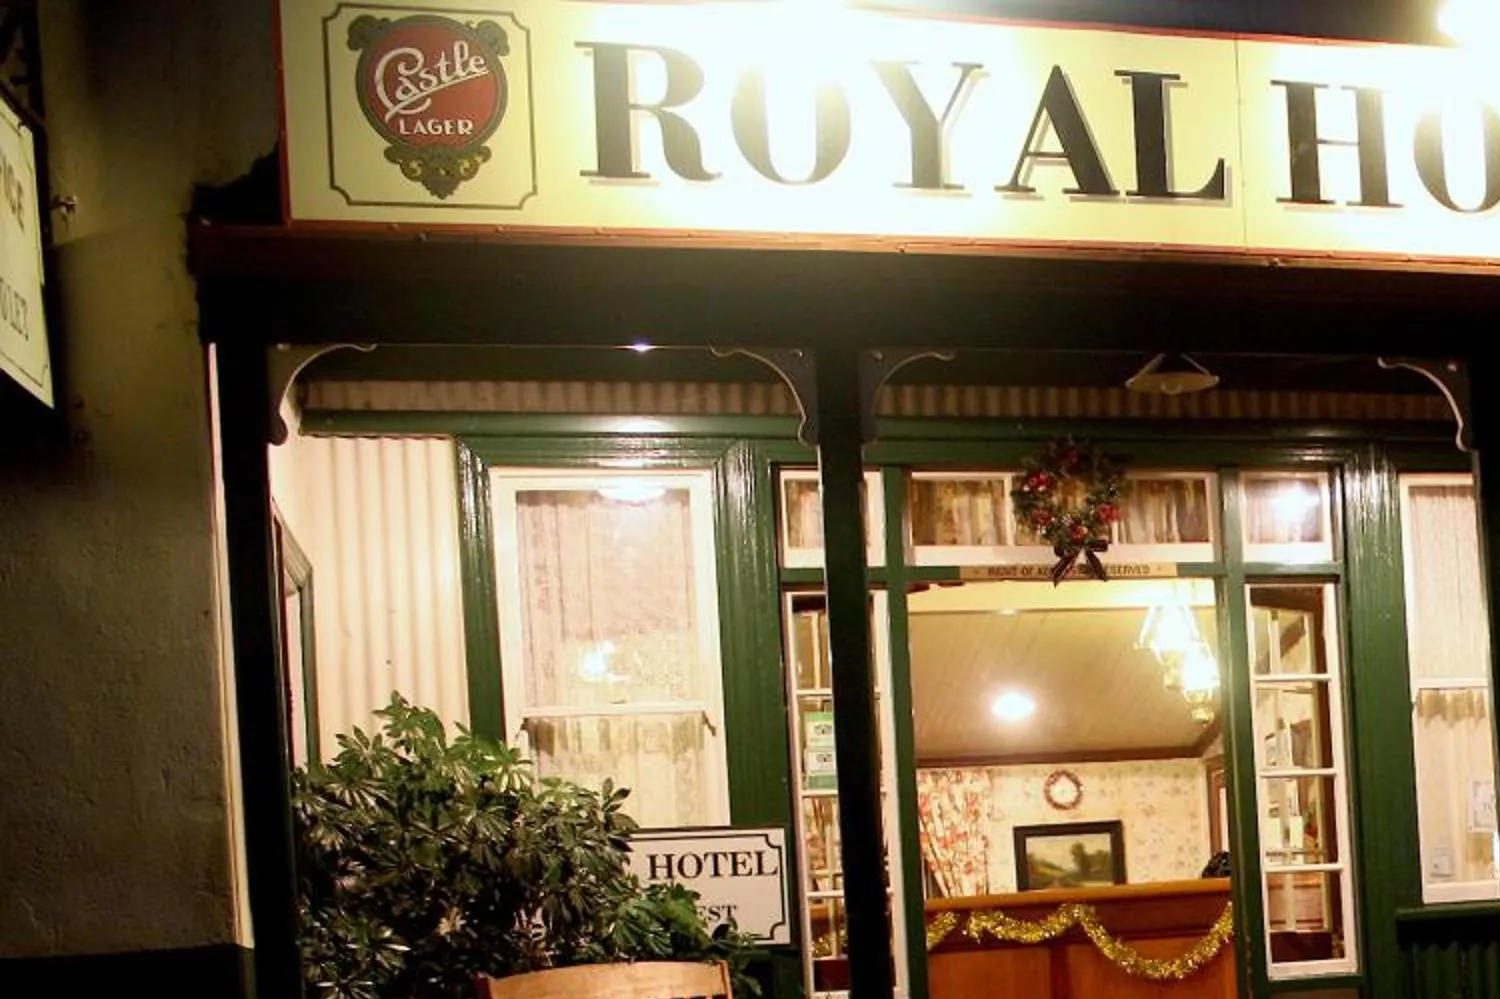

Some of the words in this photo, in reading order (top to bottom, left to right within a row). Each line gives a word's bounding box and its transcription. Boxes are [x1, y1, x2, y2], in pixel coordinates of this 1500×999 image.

[375, 41, 489, 123] Castle
[400, 118, 474, 136] LAGER
[574, 40, 1228, 203] ROYAL
[1103, 564, 1150, 576] ESERVED
[648, 851, 778, 880] HOTEL
